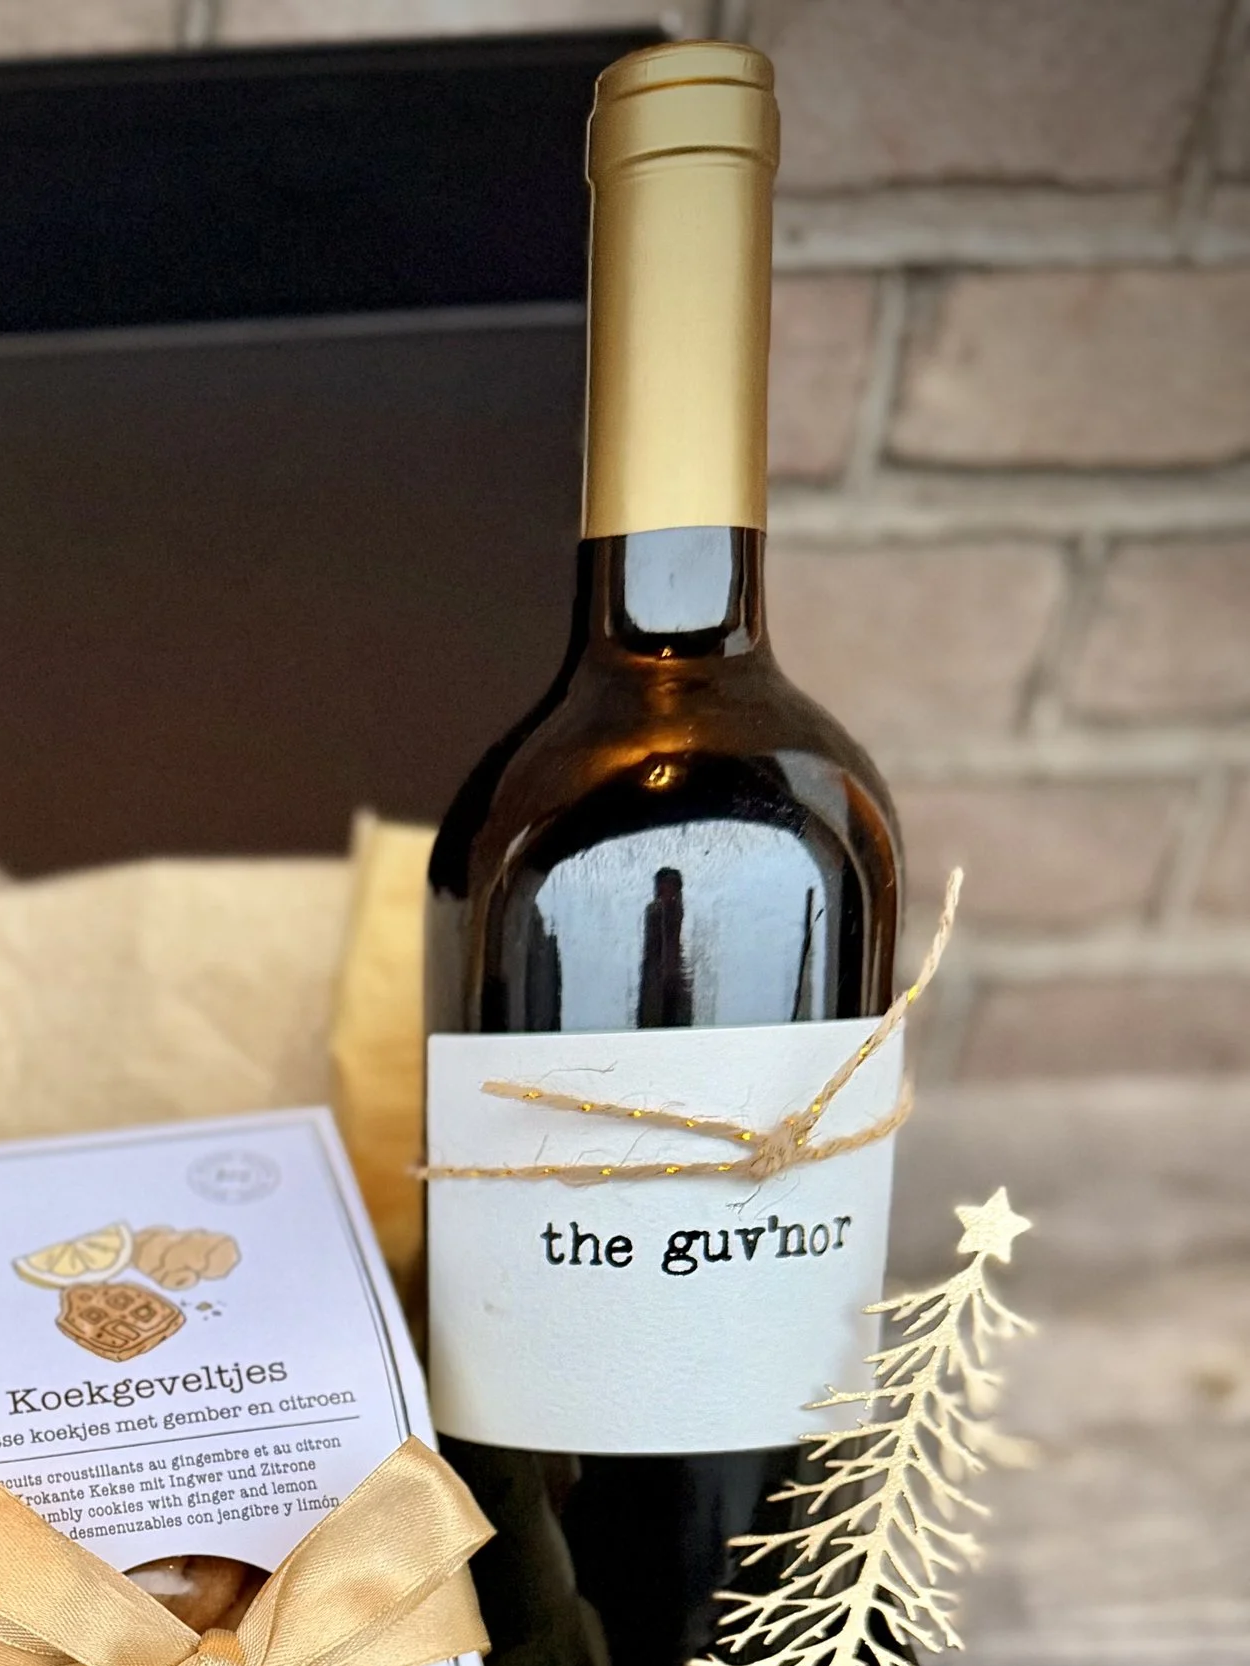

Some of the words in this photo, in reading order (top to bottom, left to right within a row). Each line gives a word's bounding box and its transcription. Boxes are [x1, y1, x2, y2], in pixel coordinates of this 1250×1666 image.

[540, 1221, 633, 1268] the
[661, 1215, 852, 1276] guv'nor
[6, 1361, 288, 1415] Koekgeveltjes
[30, 1423, 111, 1444] koekjes
[115, 1414, 158, 1433] met
[163, 1406, 242, 1430] gember
[247, 1401, 275, 1416] en
[278, 1390, 356, 1412] citroen
[47, 1461, 144, 1484] croustillants
[148, 1458, 166, 1471] au
[171, 1448, 249, 1471] gingembre
[254, 1444, 269, 1457] et
[273, 1442, 291, 1456] au
[295, 1436, 341, 1452] citron
[88, 1482, 135, 1499] Kekse
[139, 1477, 165, 1491] mit
[169, 1471, 223, 1488] Ingwer
[228, 1465, 256, 1480] und
[260, 1459, 316, 1476] Zitrone
[69, 1515, 182, 1540] desmenuzables
[187, 1511, 214, 1525] con
[216, 1501, 278, 1524] jengibre
[284, 1501, 293, 1516] y
[296, 1495, 340, 1512] limón
[88, 1498, 144, 1518] cookies
[148, 1494, 182, 1510] with
[187, 1488, 234, 1508] ginger
[240, 1484, 268, 1499] and
[272, 1479, 318, 1495] lemon
